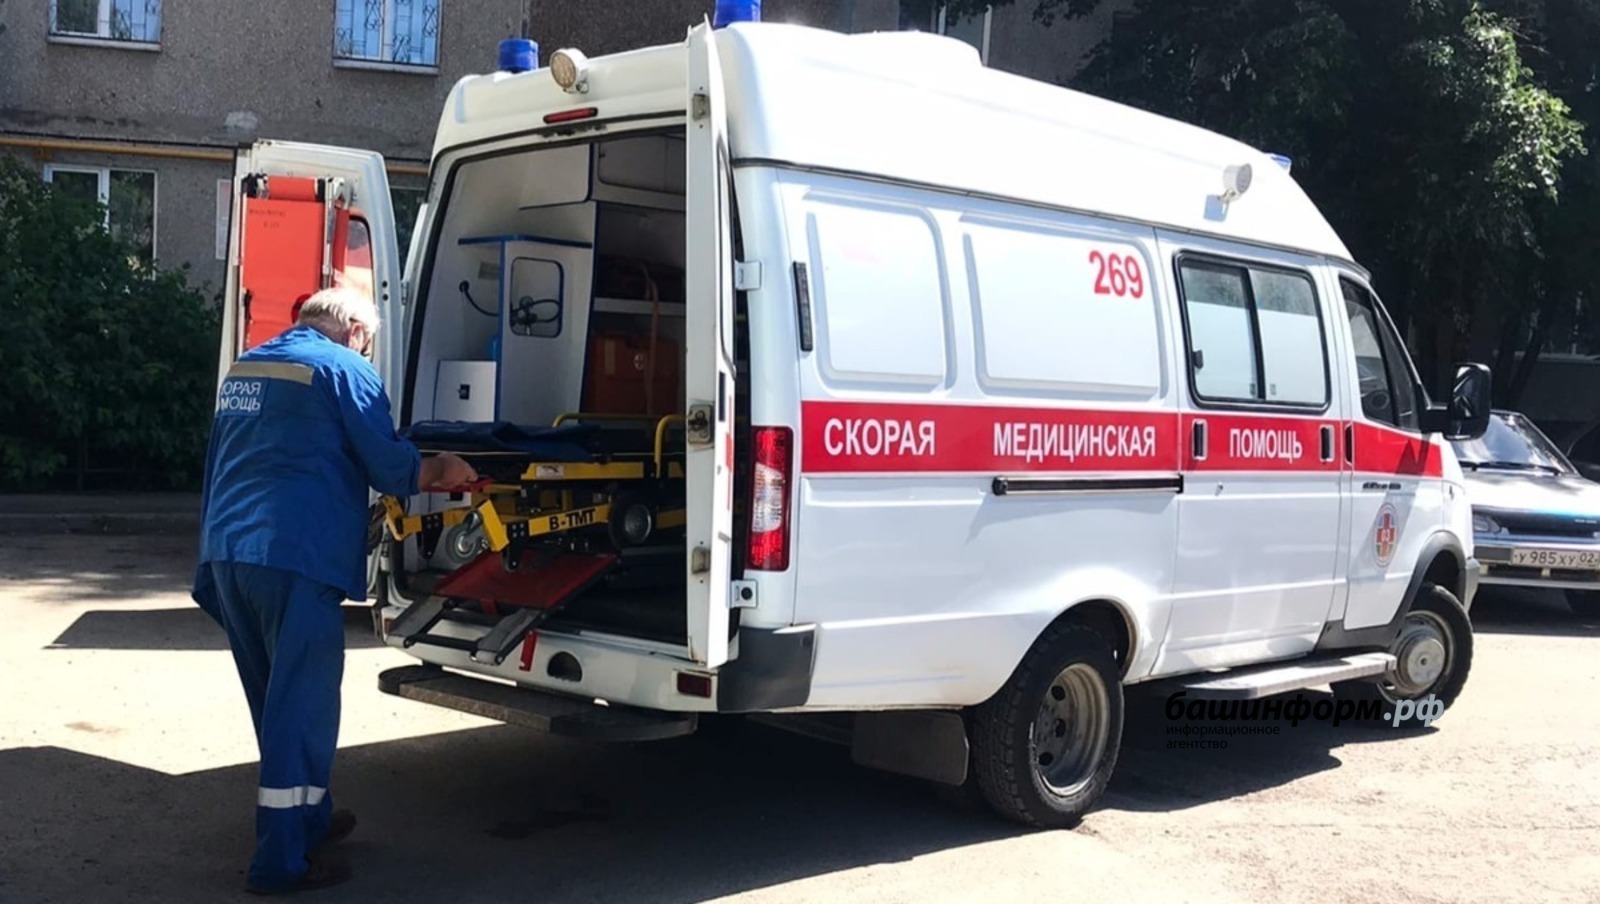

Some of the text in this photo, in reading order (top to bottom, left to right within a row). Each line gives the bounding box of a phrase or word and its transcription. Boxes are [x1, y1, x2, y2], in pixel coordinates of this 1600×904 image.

[1089, 250, 1144, 299] 269
[220, 381, 261, 396] ОРАЯ
[824, 418, 1303, 465] СКОРАЯ МЕДИЦИНСКАЯ ПОМОЩЬ
